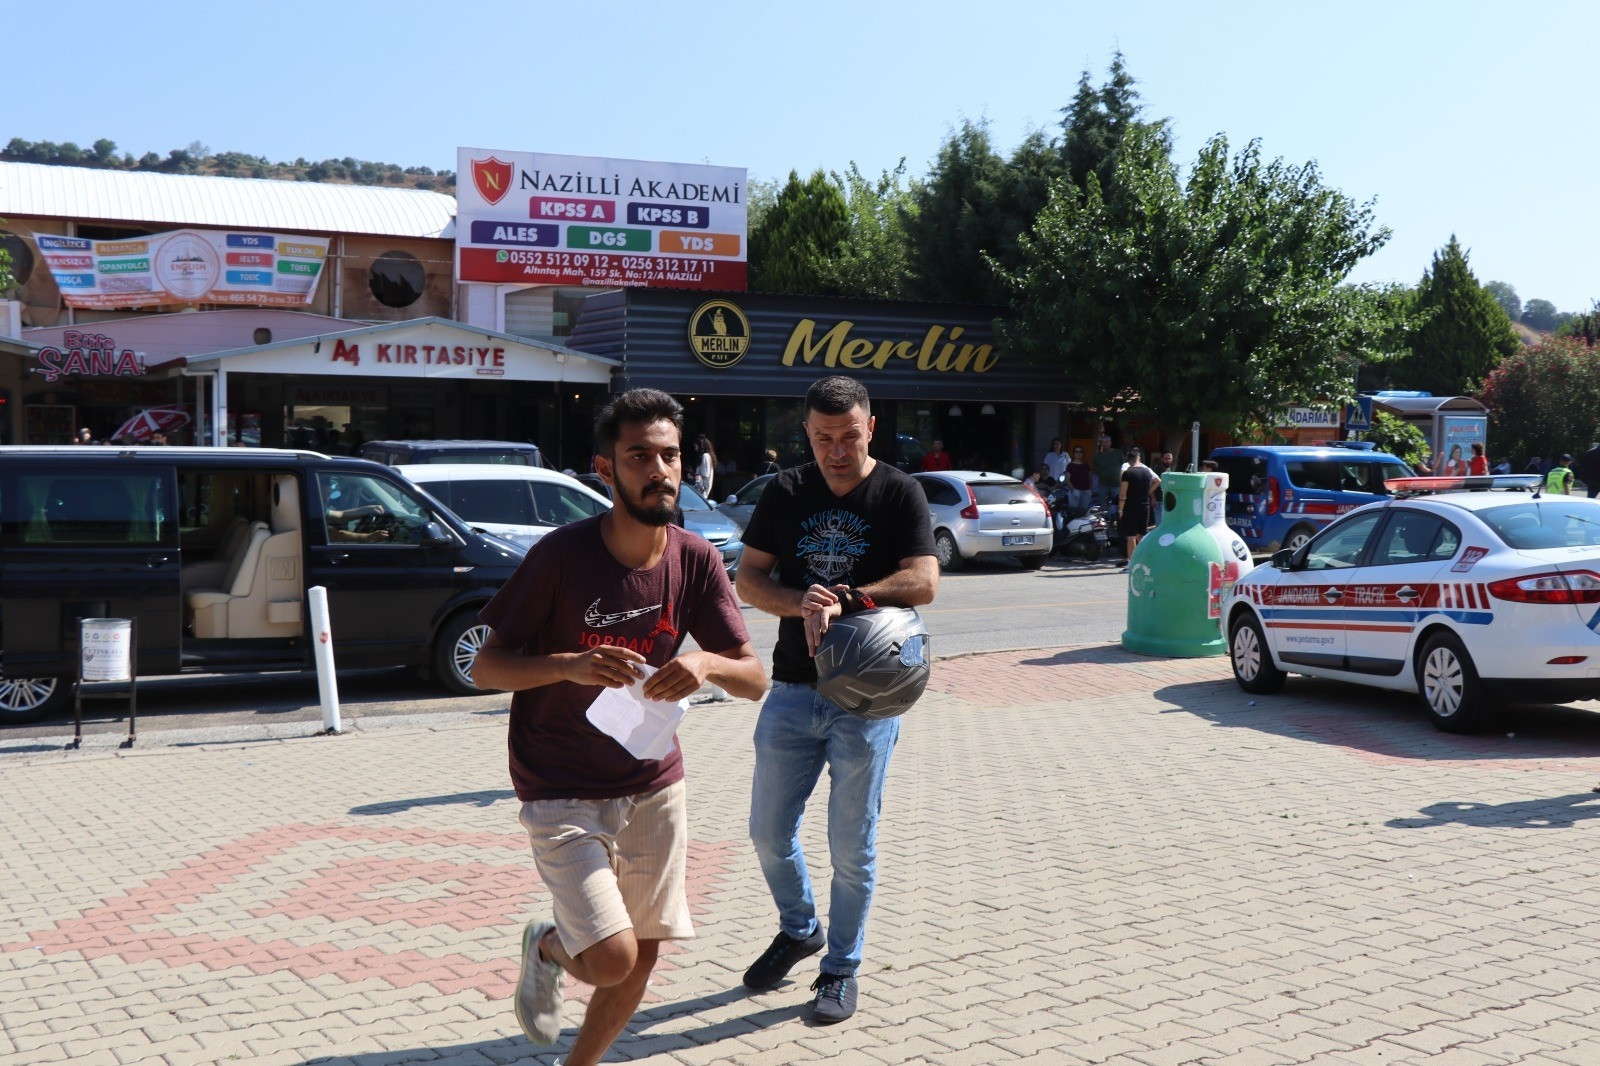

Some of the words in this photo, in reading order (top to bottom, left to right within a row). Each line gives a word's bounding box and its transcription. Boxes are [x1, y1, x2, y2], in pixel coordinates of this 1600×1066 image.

[519, 169, 620, 196] NAZİLLİ
[628, 176, 741, 204] AKADEMİ
[540, 201, 587, 219] KPSS
[592, 205, 606, 219] A
[637, 207, 683, 224] KPSS
[687, 210, 699, 224] B
[242, 237, 259, 245] YDS
[493, 226, 538, 242] ALES
[589, 230, 627, 247] DGS
[43, 238, 87, 248] İNGİLİZCE
[680, 235, 714, 251] YDS
[240, 255, 260, 263] IELTS
[290, 263, 311, 272] TOEFL
[510, 251, 542, 265] 0552
[546, 253, 570, 266] 512
[573, 254, 590, 267] 09
[594, 255, 609, 268] 12
[622, 256, 653, 270] 0256
[656, 258, 679, 271] 312
[683, 259, 698, 272] 17
[702, 261, 715, 273] 11
[239, 273, 260, 281] TOEIC
[523, 265, 560, 278] Altıntaş
[562, 267, 587, 277] Mah.
[590, 268, 607, 277] 159
[608, 269, 623, 278] Sk.
[625, 270, 664, 280] No:12/A
[666, 271, 702, 282] NAZİLLİ
[63, 330, 116, 350] Büfe
[701, 337, 739, 351] MERLIN
[781, 318, 1001, 374] Merlin
[331, 338, 360, 366] A4
[376, 343, 505, 367] KIRTASİYE
[37, 347, 143, 382] ŞANA
[1287, 411, 1329, 424] NDARMA
[1462, 549, 1484, 563] 112
[1278, 586, 1320, 604] JANDARMA
[1354, 586, 1386, 604] TRAFİK
[578, 631, 655, 655] JORDAN
